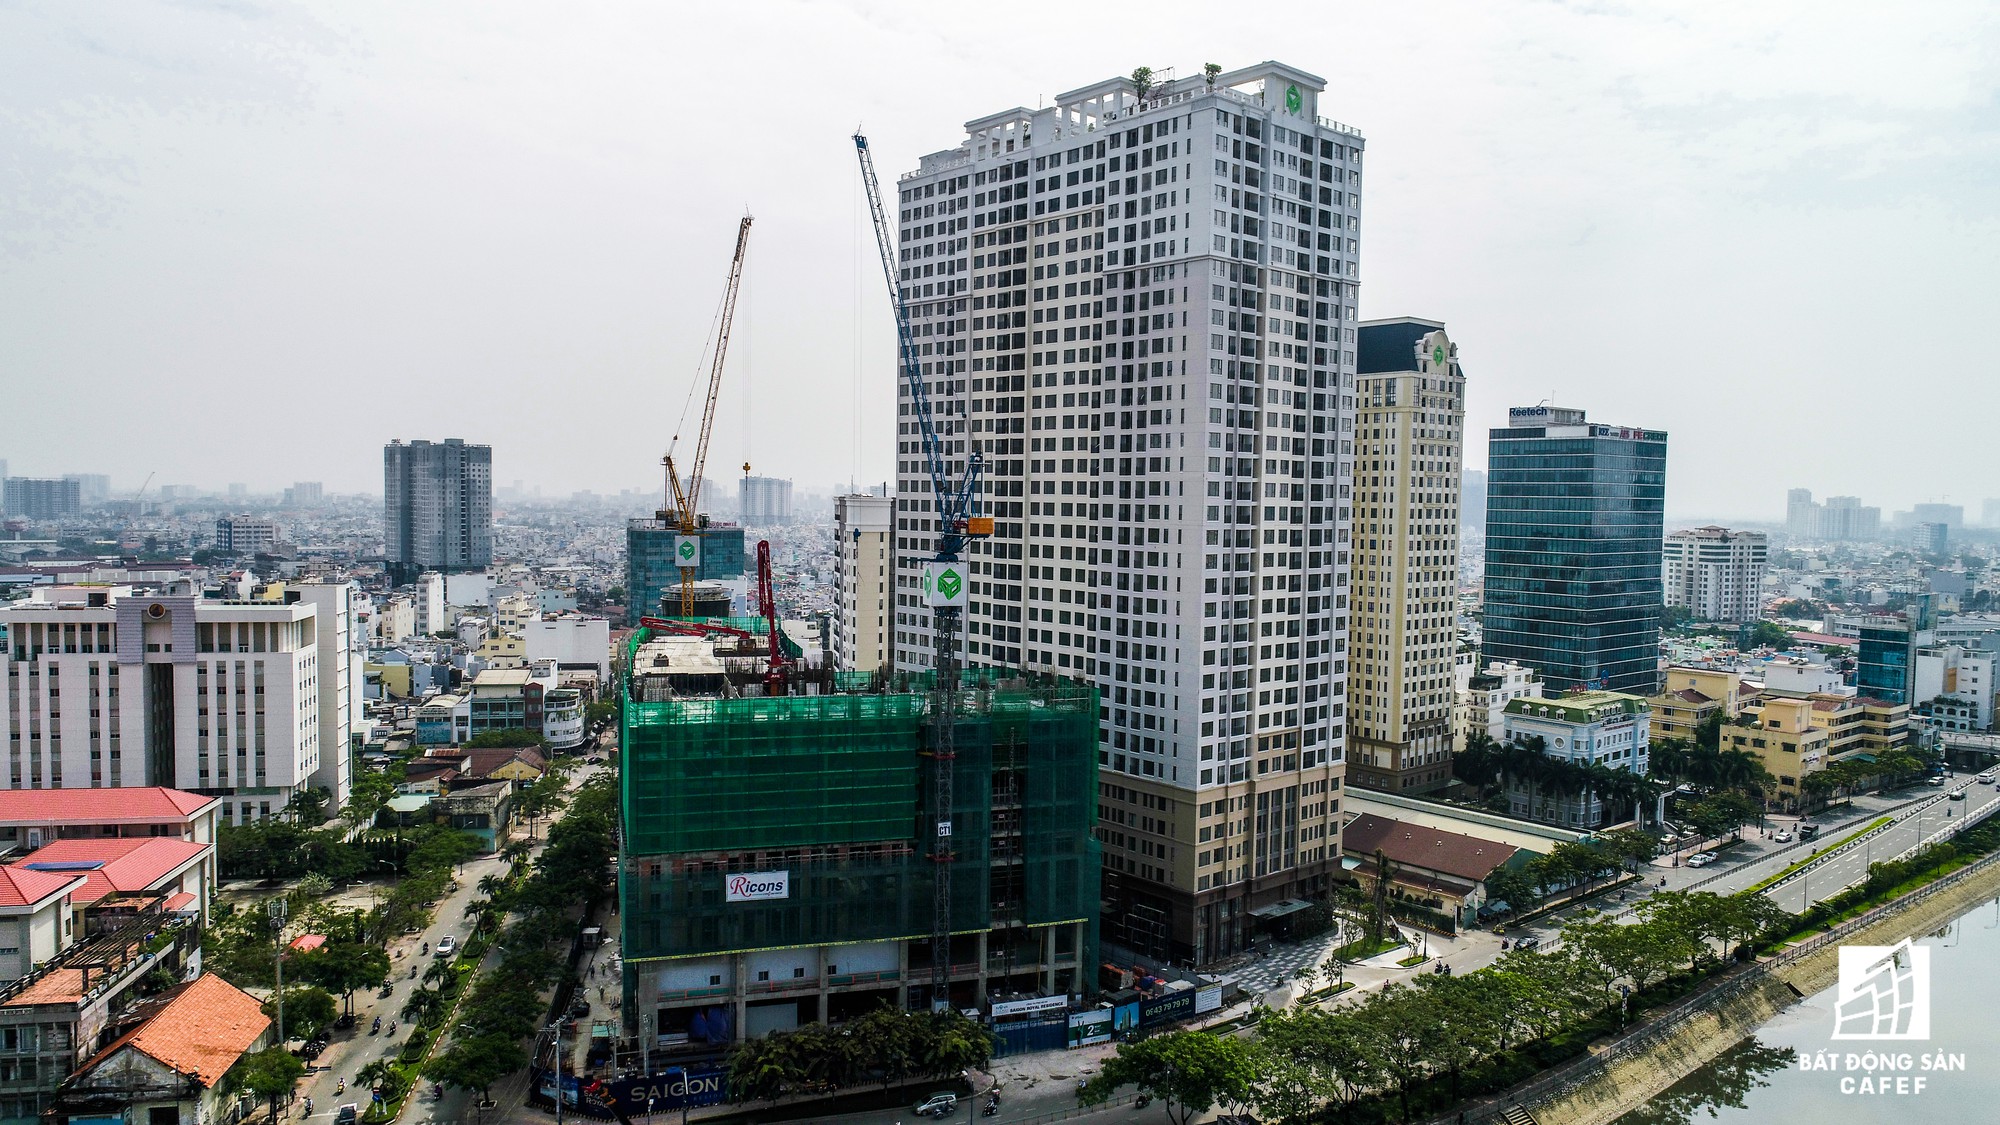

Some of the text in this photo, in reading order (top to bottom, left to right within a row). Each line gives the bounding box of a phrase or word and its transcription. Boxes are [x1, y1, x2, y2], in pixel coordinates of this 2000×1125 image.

[1509, 407, 1548, 416] Reetech
[730, 876, 784, 897] Ricons
[1040, 1001, 1064, 1009] RESIDENCE
[1163, 1002, 1172, 1011] 79
[1172, 1000, 1181, 1009] 79
[1181, 997, 1190, 1006] 79
[1087, 1025, 1094, 1036] 2
[631, 1078, 719, 1102] SAIGON
